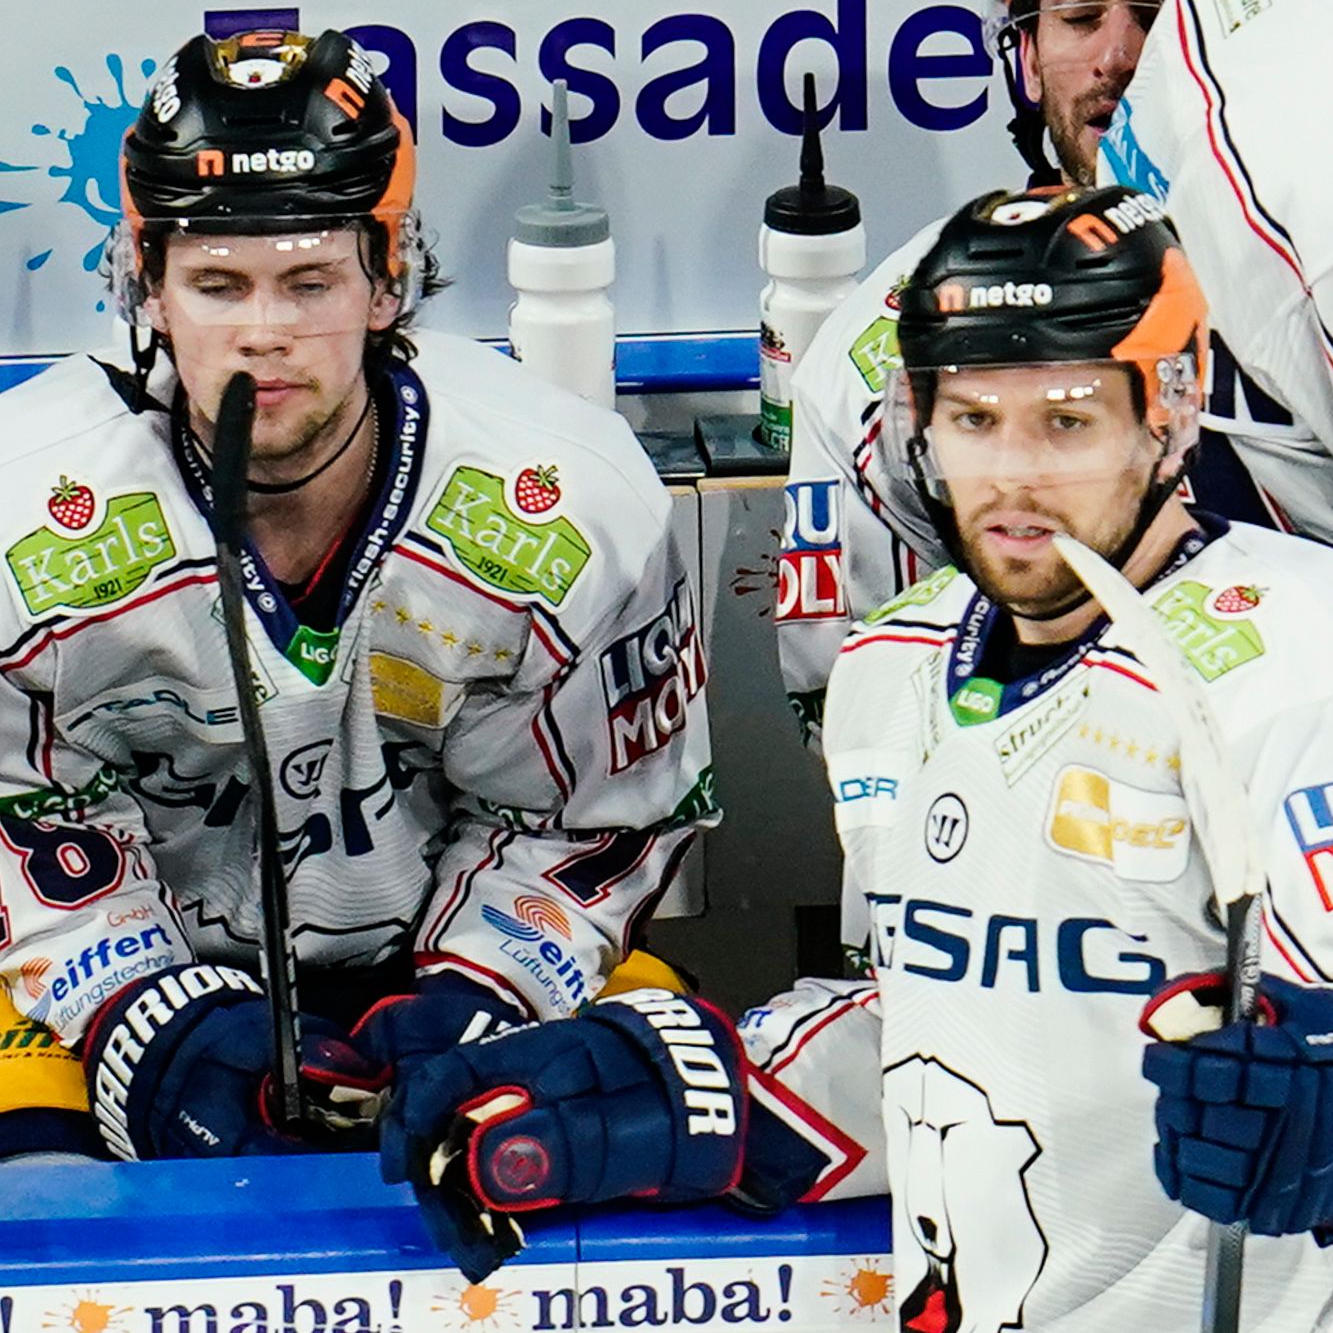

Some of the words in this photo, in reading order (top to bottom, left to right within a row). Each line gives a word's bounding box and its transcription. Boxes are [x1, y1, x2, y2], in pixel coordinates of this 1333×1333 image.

[232, 149, 315, 173] netgo
[969, 281, 1053, 308] netgo
[17, 512, 168, 600] Karls
[436, 481, 572, 596] Karls
[864, 892, 1167, 995] SAG
[95, 965, 265, 1162] WARRIOR
[144, 1278, 403, 1333] maba!
[532, 1266, 795, 1331] maba!
